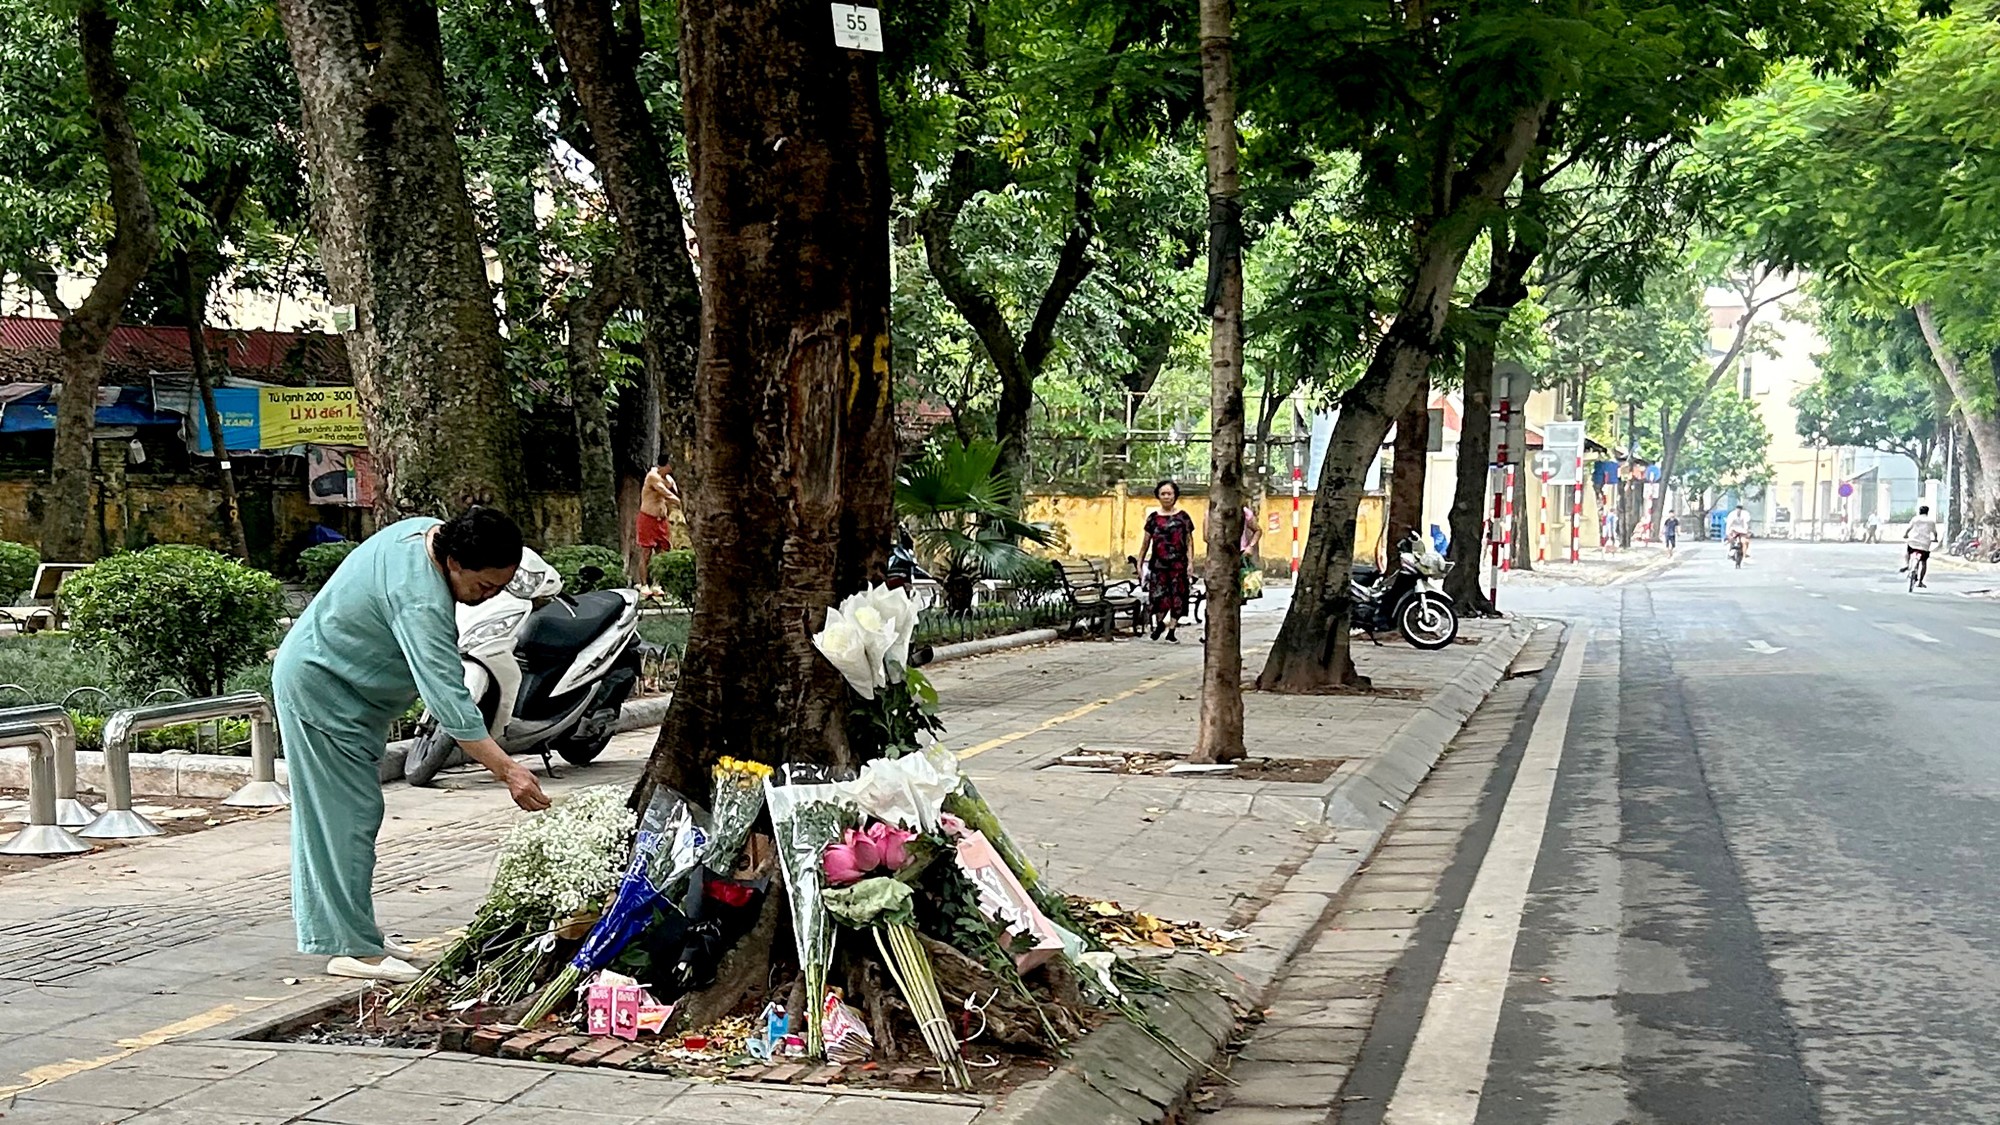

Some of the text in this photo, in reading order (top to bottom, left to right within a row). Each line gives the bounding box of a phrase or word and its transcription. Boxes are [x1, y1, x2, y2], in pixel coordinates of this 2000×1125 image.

[846, 13, 867, 31] 55
[268, 392, 280, 403] Tủ
[282, 392, 304, 406] lạnh
[305, 391, 325, 402] 200
[333, 391, 353, 401] 300
[319, 404, 343, 419] đến
